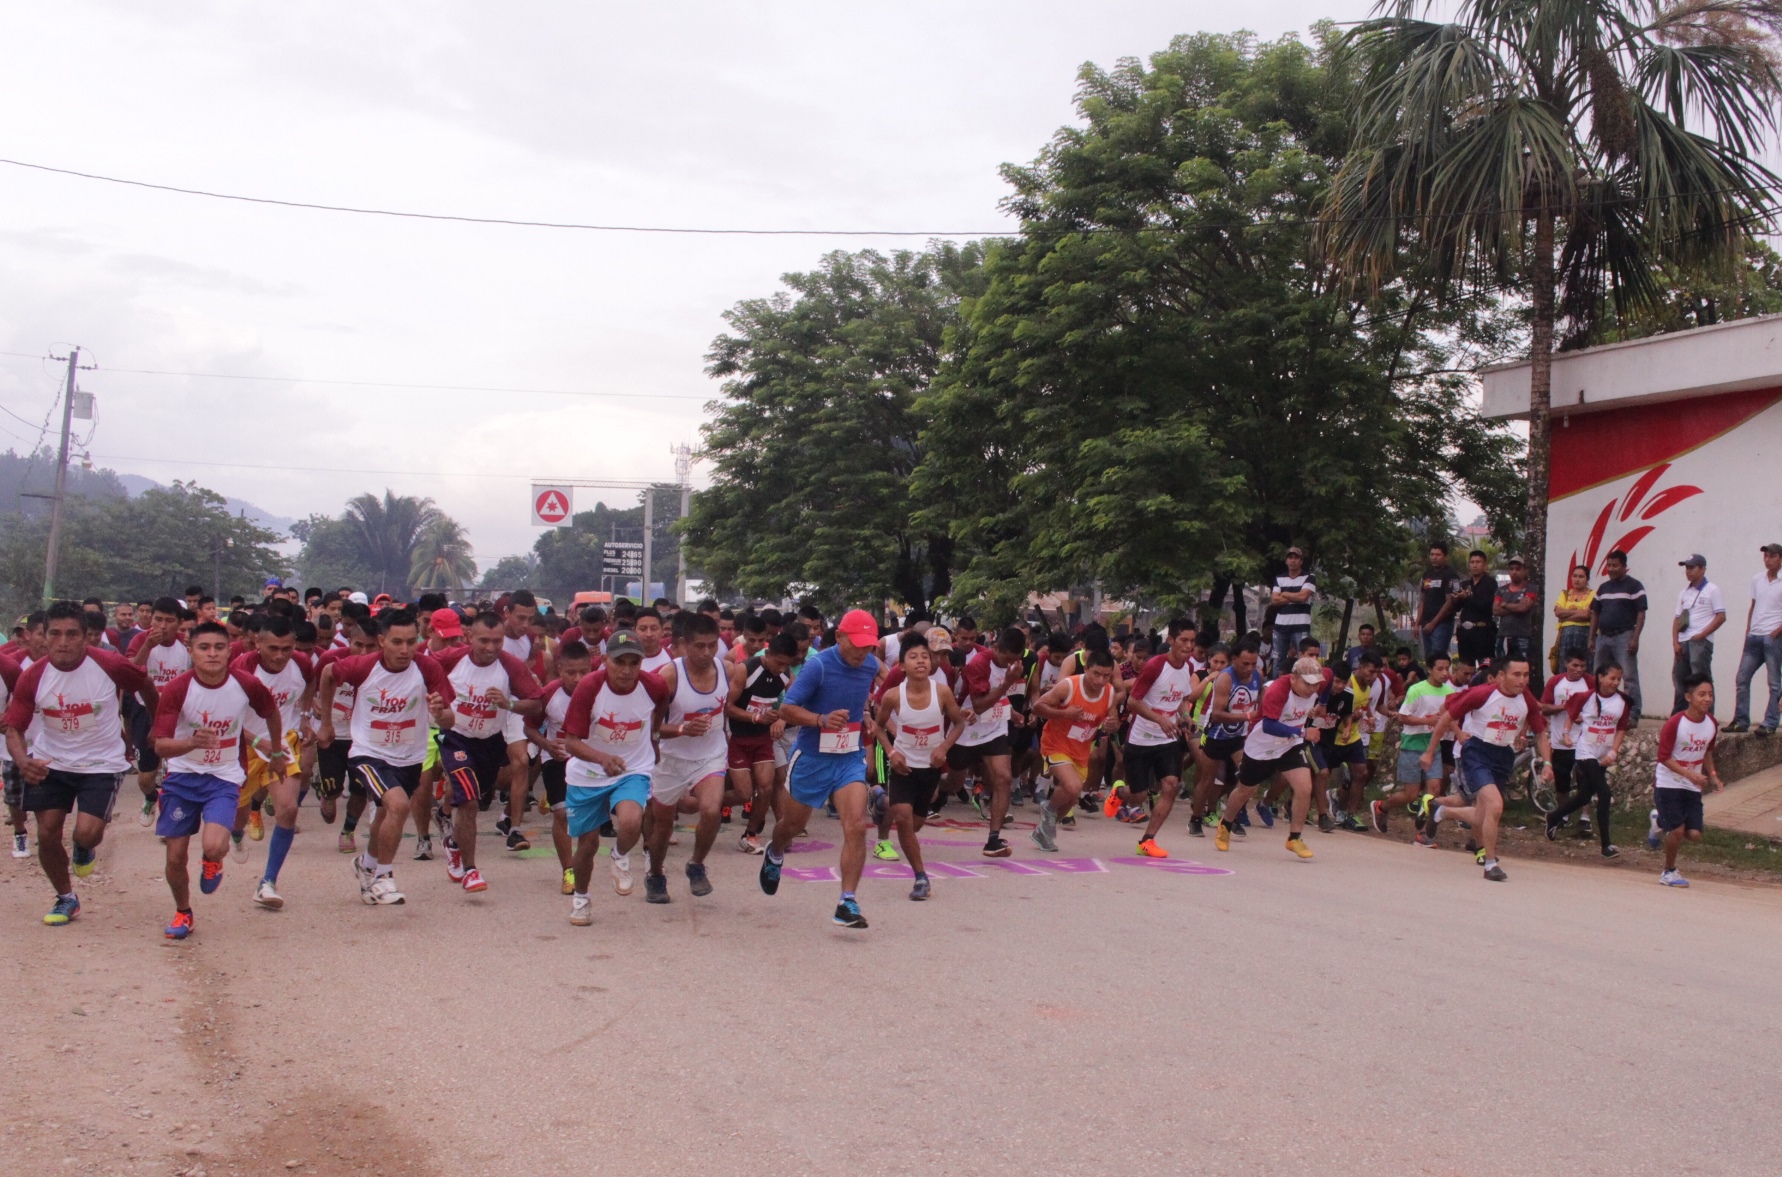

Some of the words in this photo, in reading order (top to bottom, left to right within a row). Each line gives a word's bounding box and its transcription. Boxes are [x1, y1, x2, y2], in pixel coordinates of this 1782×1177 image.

[385, 697, 408, 707] 10K
[370, 704, 406, 714] FRAY
[61, 718, 79, 730] 379
[208, 719, 232, 729] 10K
[467, 718, 485, 731] 416
[384, 730, 401, 743] 315
[609, 729, 627, 742] 064
[914, 735, 928, 747] 722
[203, 749, 221, 763] 324
